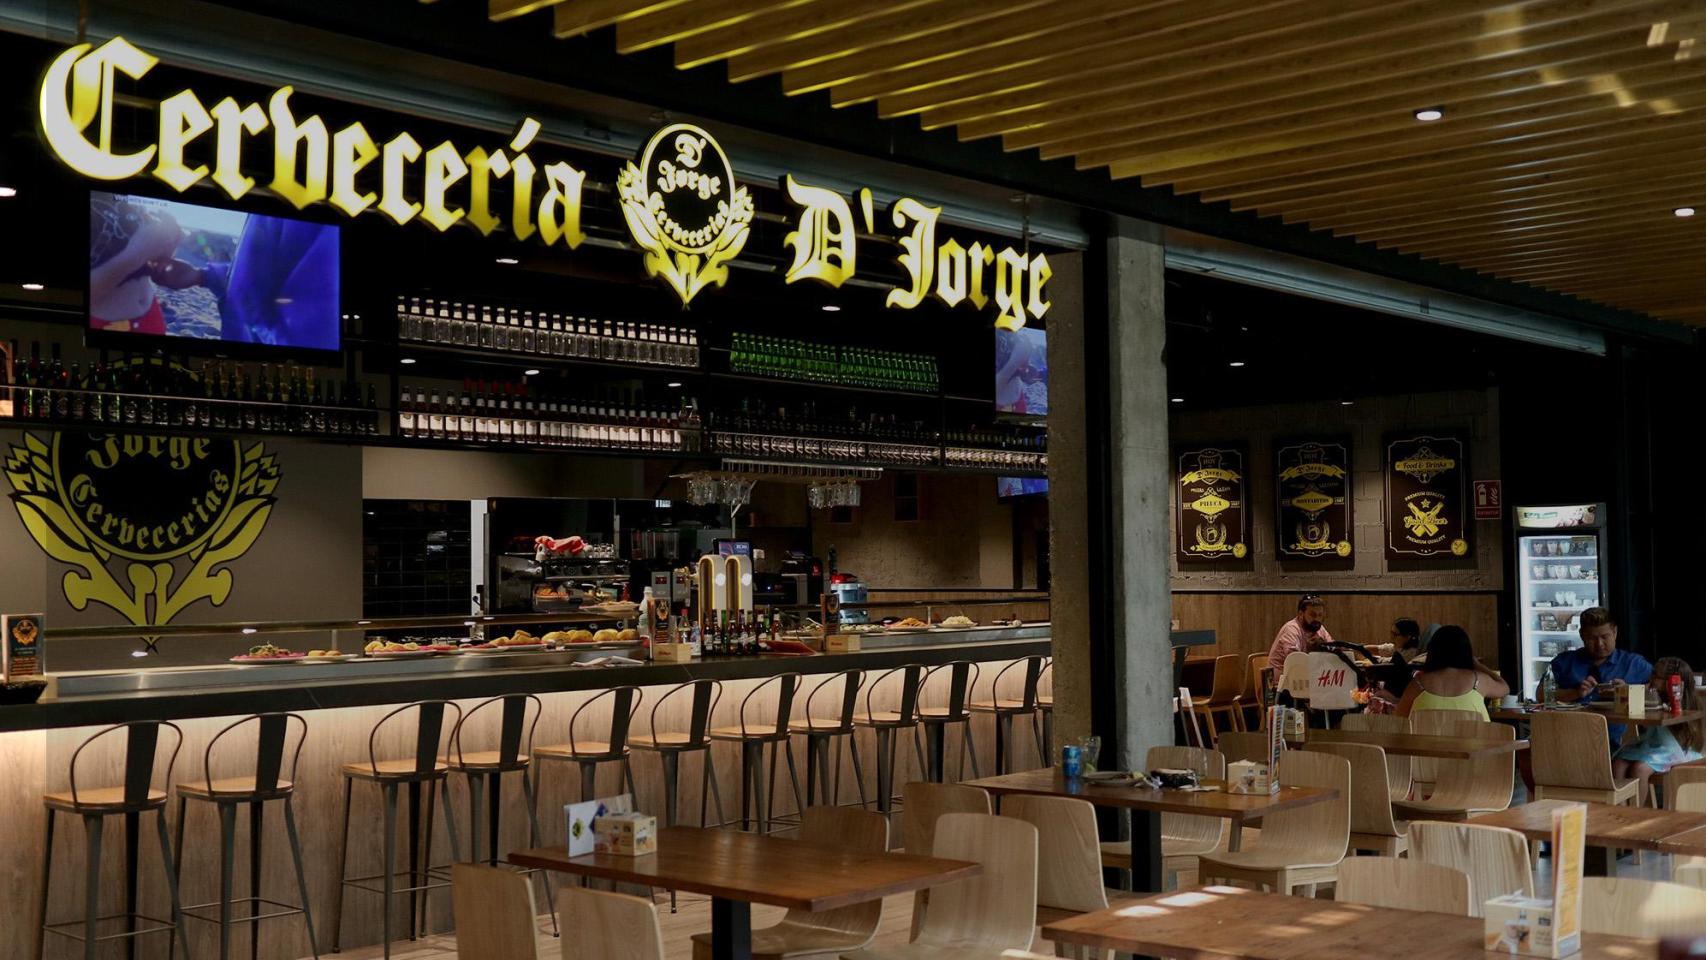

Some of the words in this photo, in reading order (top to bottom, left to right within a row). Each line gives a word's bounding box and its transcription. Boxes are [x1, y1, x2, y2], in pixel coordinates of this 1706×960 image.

[39, 35, 587, 251] Cervecería
[657, 159, 722, 200] Jorge
[1318, 669, 1345, 687] H&M
